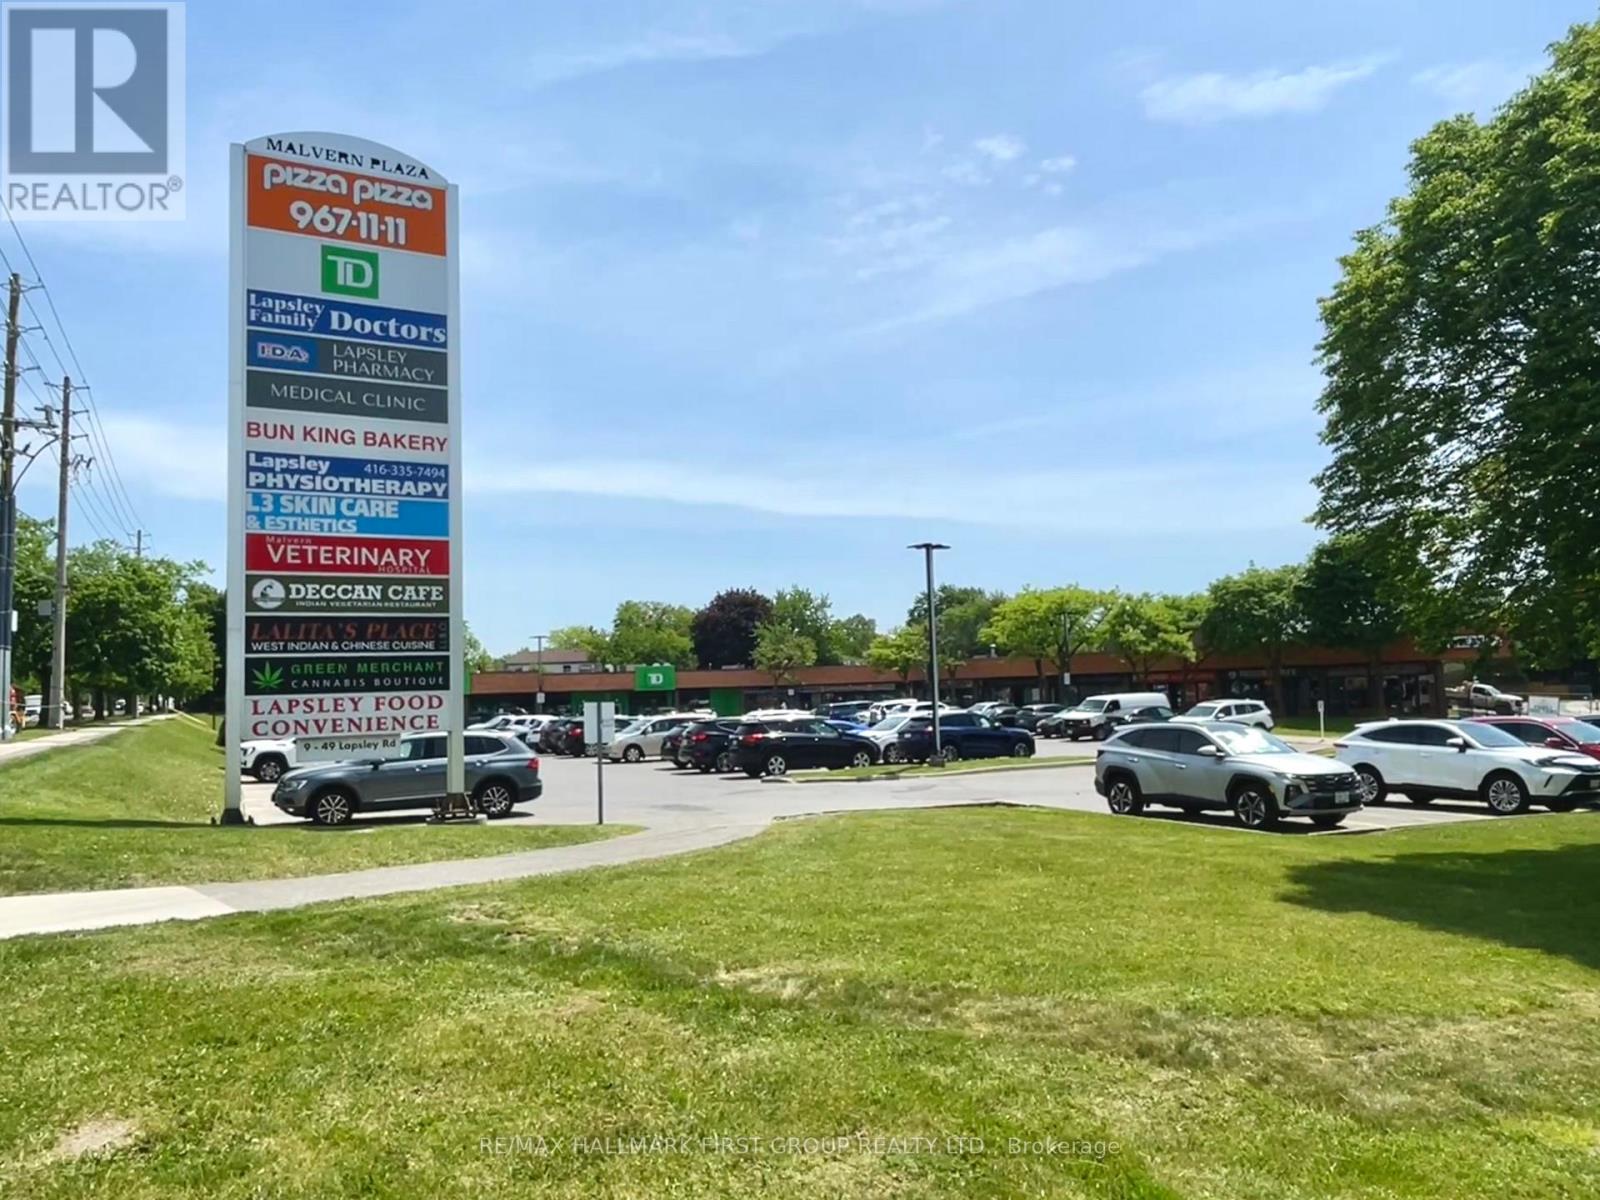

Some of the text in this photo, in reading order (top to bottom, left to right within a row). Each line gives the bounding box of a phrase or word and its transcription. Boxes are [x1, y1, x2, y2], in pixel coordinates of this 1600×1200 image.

[266, 138, 430, 180] MALVERN PLAZA
[327, 255, 373, 289] TD
[250, 293, 325, 316] Lapsley
[250, 308, 318, 331] Family
[329, 310, 447, 343] Doctors
[333, 344, 407, 364] LAPSLEY
[333, 360, 435, 382] PHARMACY
[271, 383, 426, 411] MEDICAL CLINIC
[246, 421, 448, 452] BUN KING BAKERY
[249, 453, 330, 475] Lapsley
[364, 463, 446, 479] 416-335-7494
[249, 472, 448, 497] PHYSIOTHERAPY
[247, 493, 399, 519] L3 SKIN CARE
[246, 515, 358, 533] & ESTHETICS
[266, 535, 312, 545] Malvern
[267, 544, 432, 567] VETERINARY
[378, 565, 432, 575] HOSPITAL
[289, 584, 444, 601] DECCAN CAFE
[251, 622, 437, 641] LALITA'S PLACE
[251, 640, 435, 652] WEST INDIAN & CHINESE CUISINE
[291, 661, 444, 675] GREEN MERCHANT
[291, 676, 444, 689] CANNABIS BOUTIQUE
[252, 694, 444, 716] LAPSLEY FOOD
[252, 715, 440, 737] CONVENIENCE
[304, 742, 311, 751] 9
[321, 741, 336, 751] 49
[339, 739, 381, 753] Lapsley
[382, 739, 396, 748] Rd
